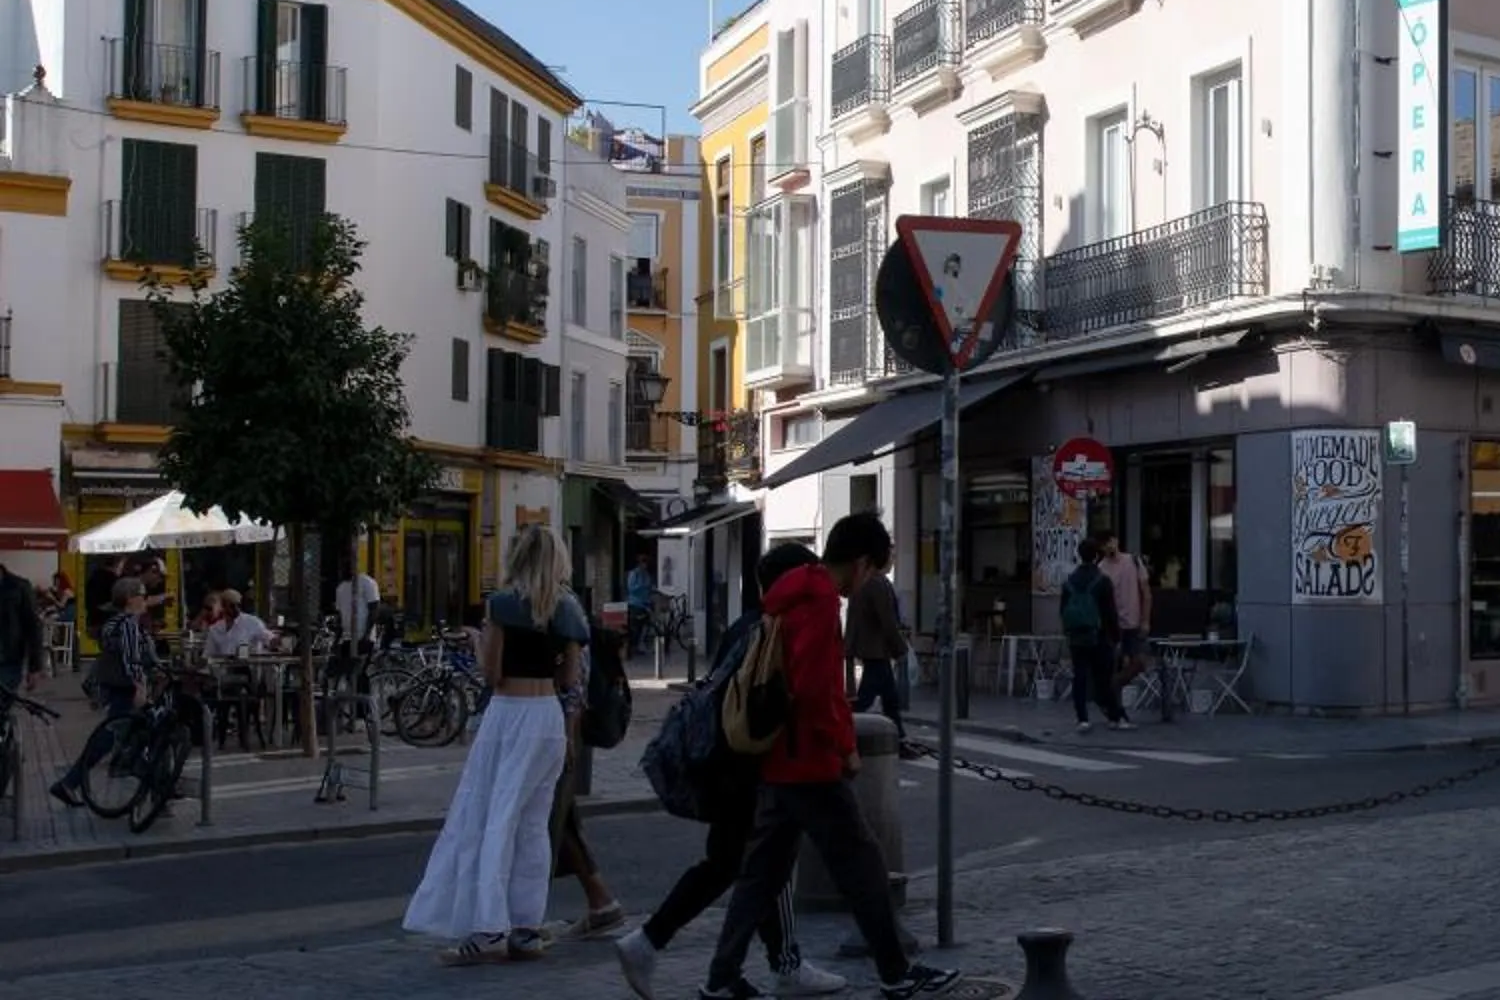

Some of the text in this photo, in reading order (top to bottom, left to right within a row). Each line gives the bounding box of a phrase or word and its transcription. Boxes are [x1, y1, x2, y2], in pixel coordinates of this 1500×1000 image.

[1411, 16, 1427, 217] ÓPERA
[1296, 435, 1378, 477] HOMEMADE
[1305, 459, 1363, 487] FOOD
[1296, 552, 1375, 597] SALADS
